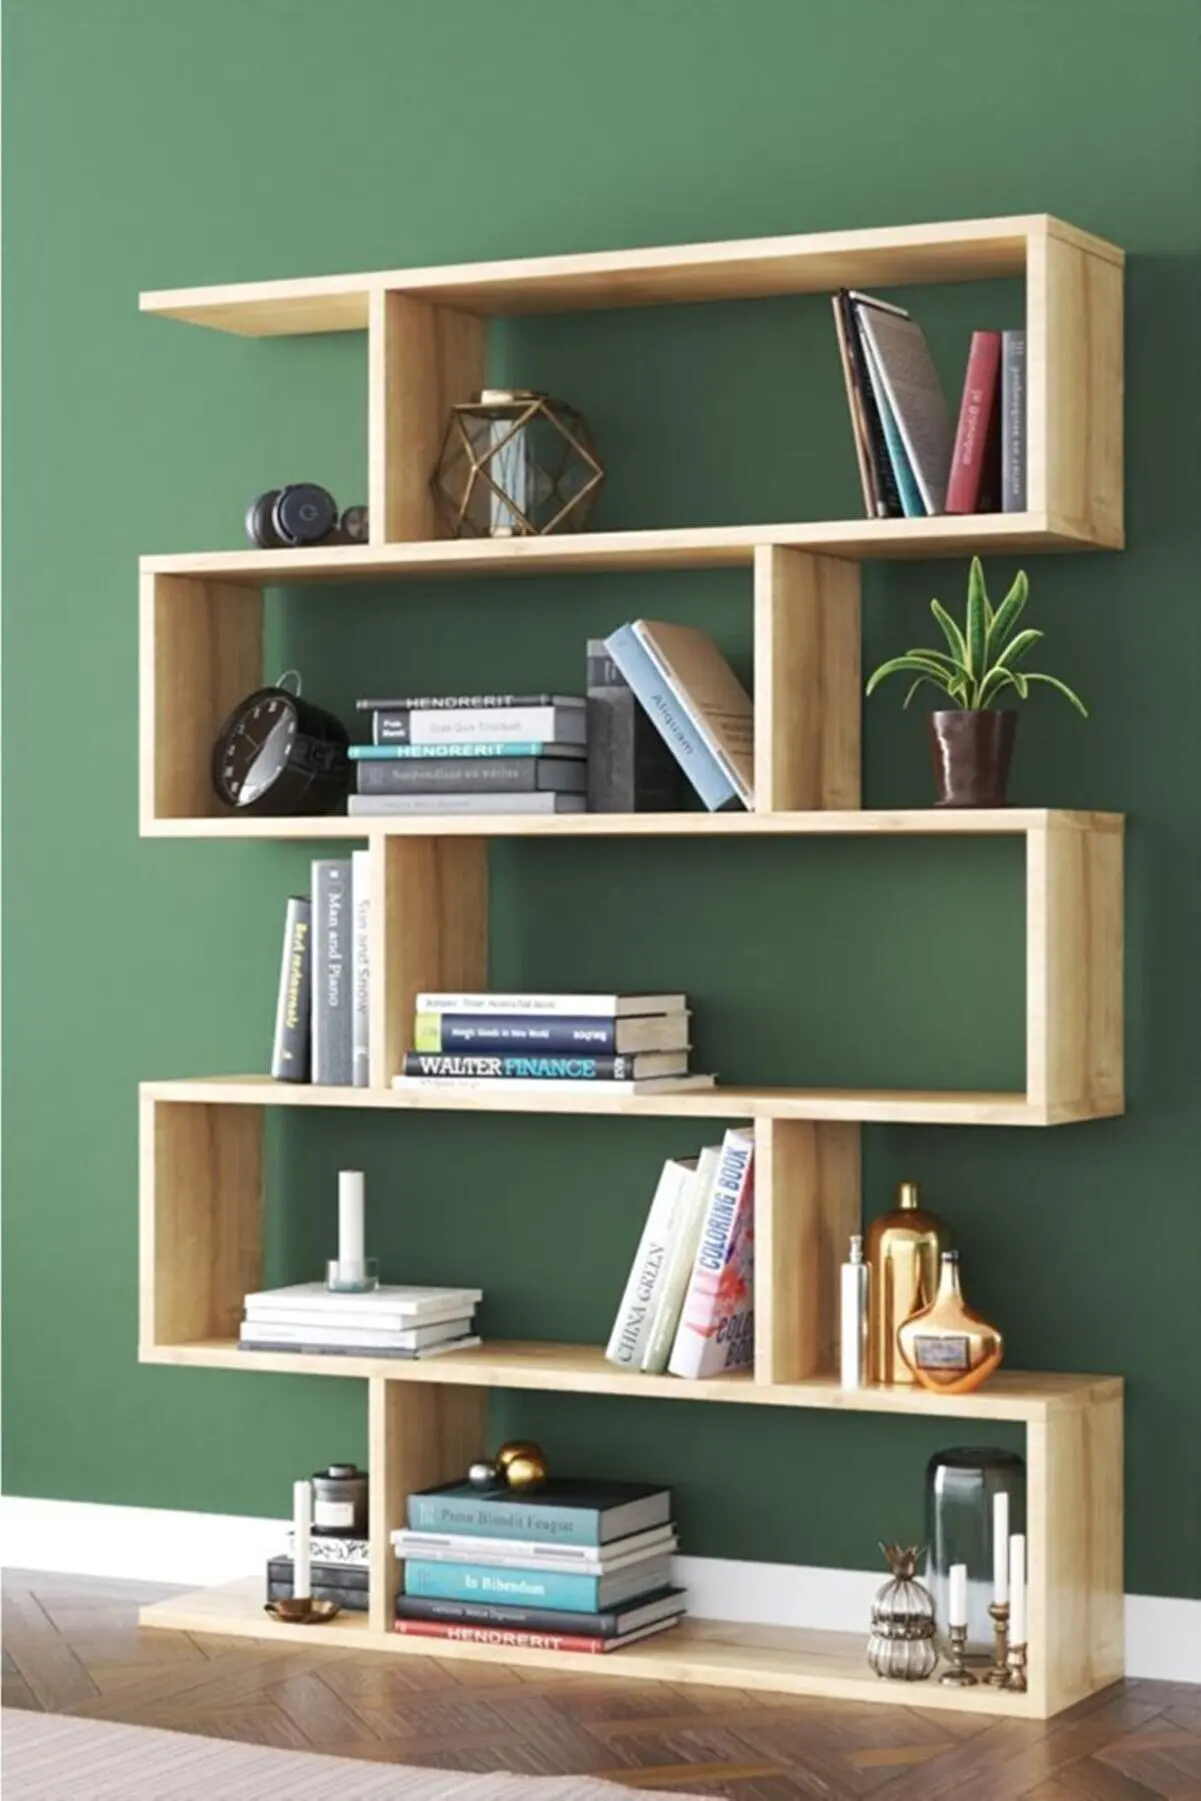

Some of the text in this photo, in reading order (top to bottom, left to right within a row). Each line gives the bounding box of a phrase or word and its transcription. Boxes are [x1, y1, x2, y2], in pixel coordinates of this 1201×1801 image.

[405, 695, 515, 709] HENDRERIT
[397, 744, 505, 758] HENDRERIT
[327, 892, 343, 1008] Man and Piano
[418, 1055, 503, 1076] WALTER
[504, 1056, 597, 1078] FINANCE
[699, 1146, 749, 1271] COLORING BOOK
[617, 1242, 665, 1363] CHINA GREEN
[481, 1576, 546, 1596] Bibendum
[446, 1627, 563, 1650] HENDRERIT
